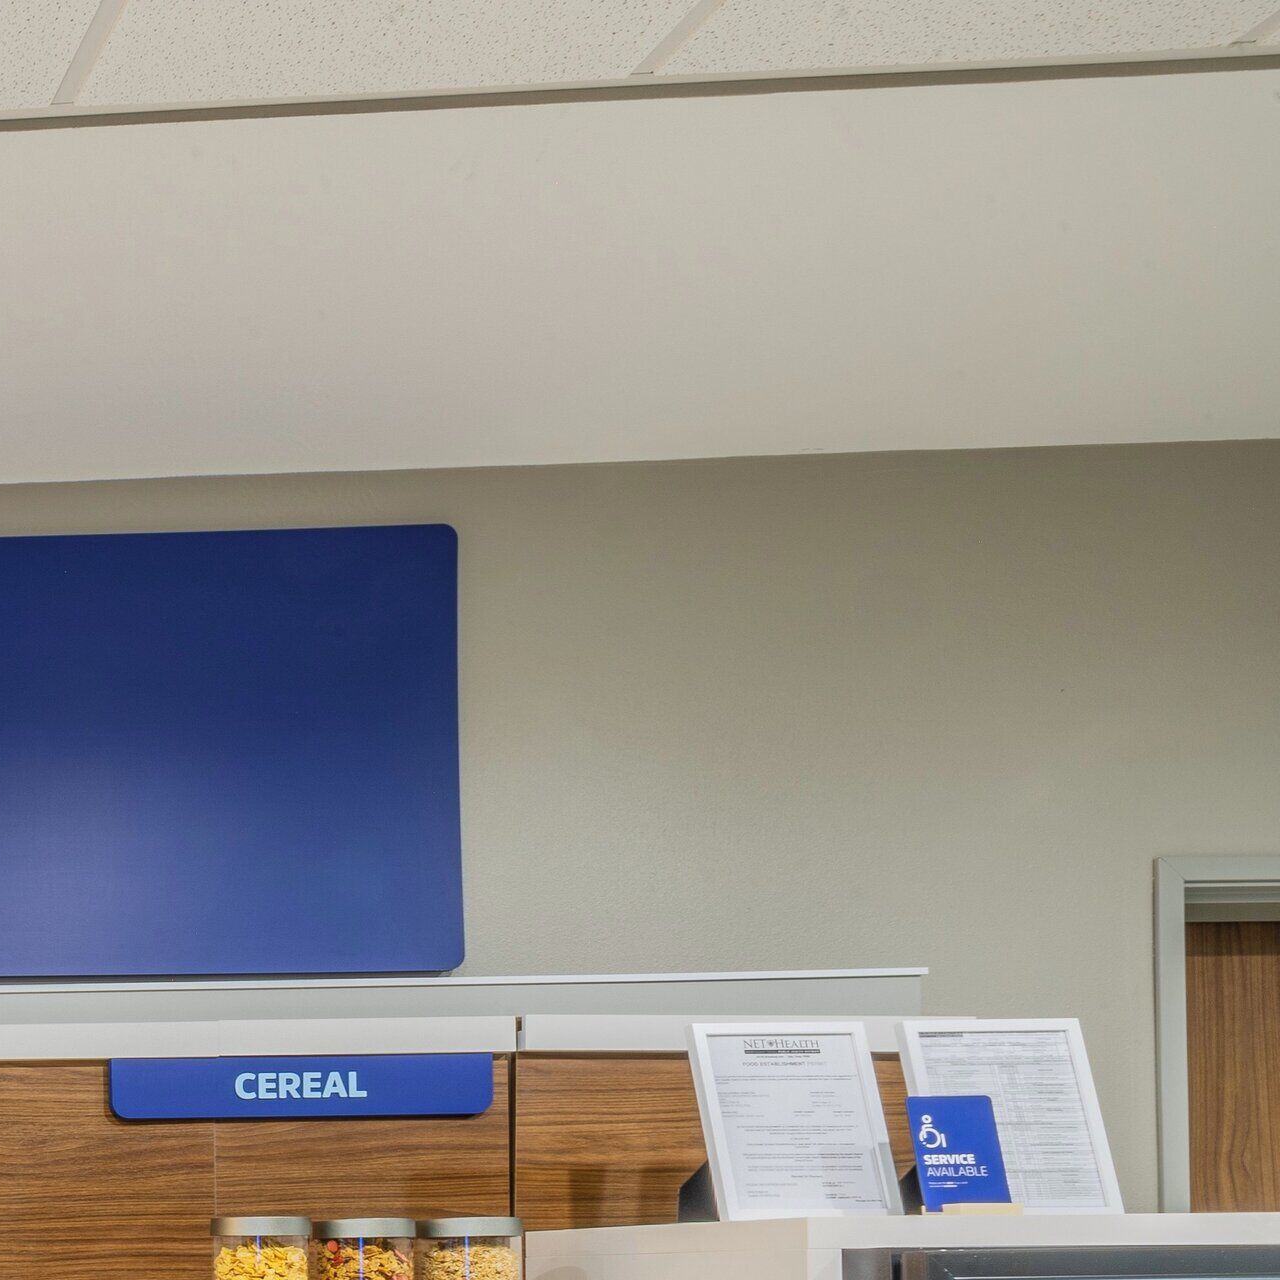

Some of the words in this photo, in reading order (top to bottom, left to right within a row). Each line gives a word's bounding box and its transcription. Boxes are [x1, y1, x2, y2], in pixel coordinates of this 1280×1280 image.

[744, 1039, 765, 1048] NET
[234, 1071, 368, 1100] CEREAL
[923, 1153, 976, 1165] SERVICE
[927, 1165, 989, 1177] AVAILABLE
